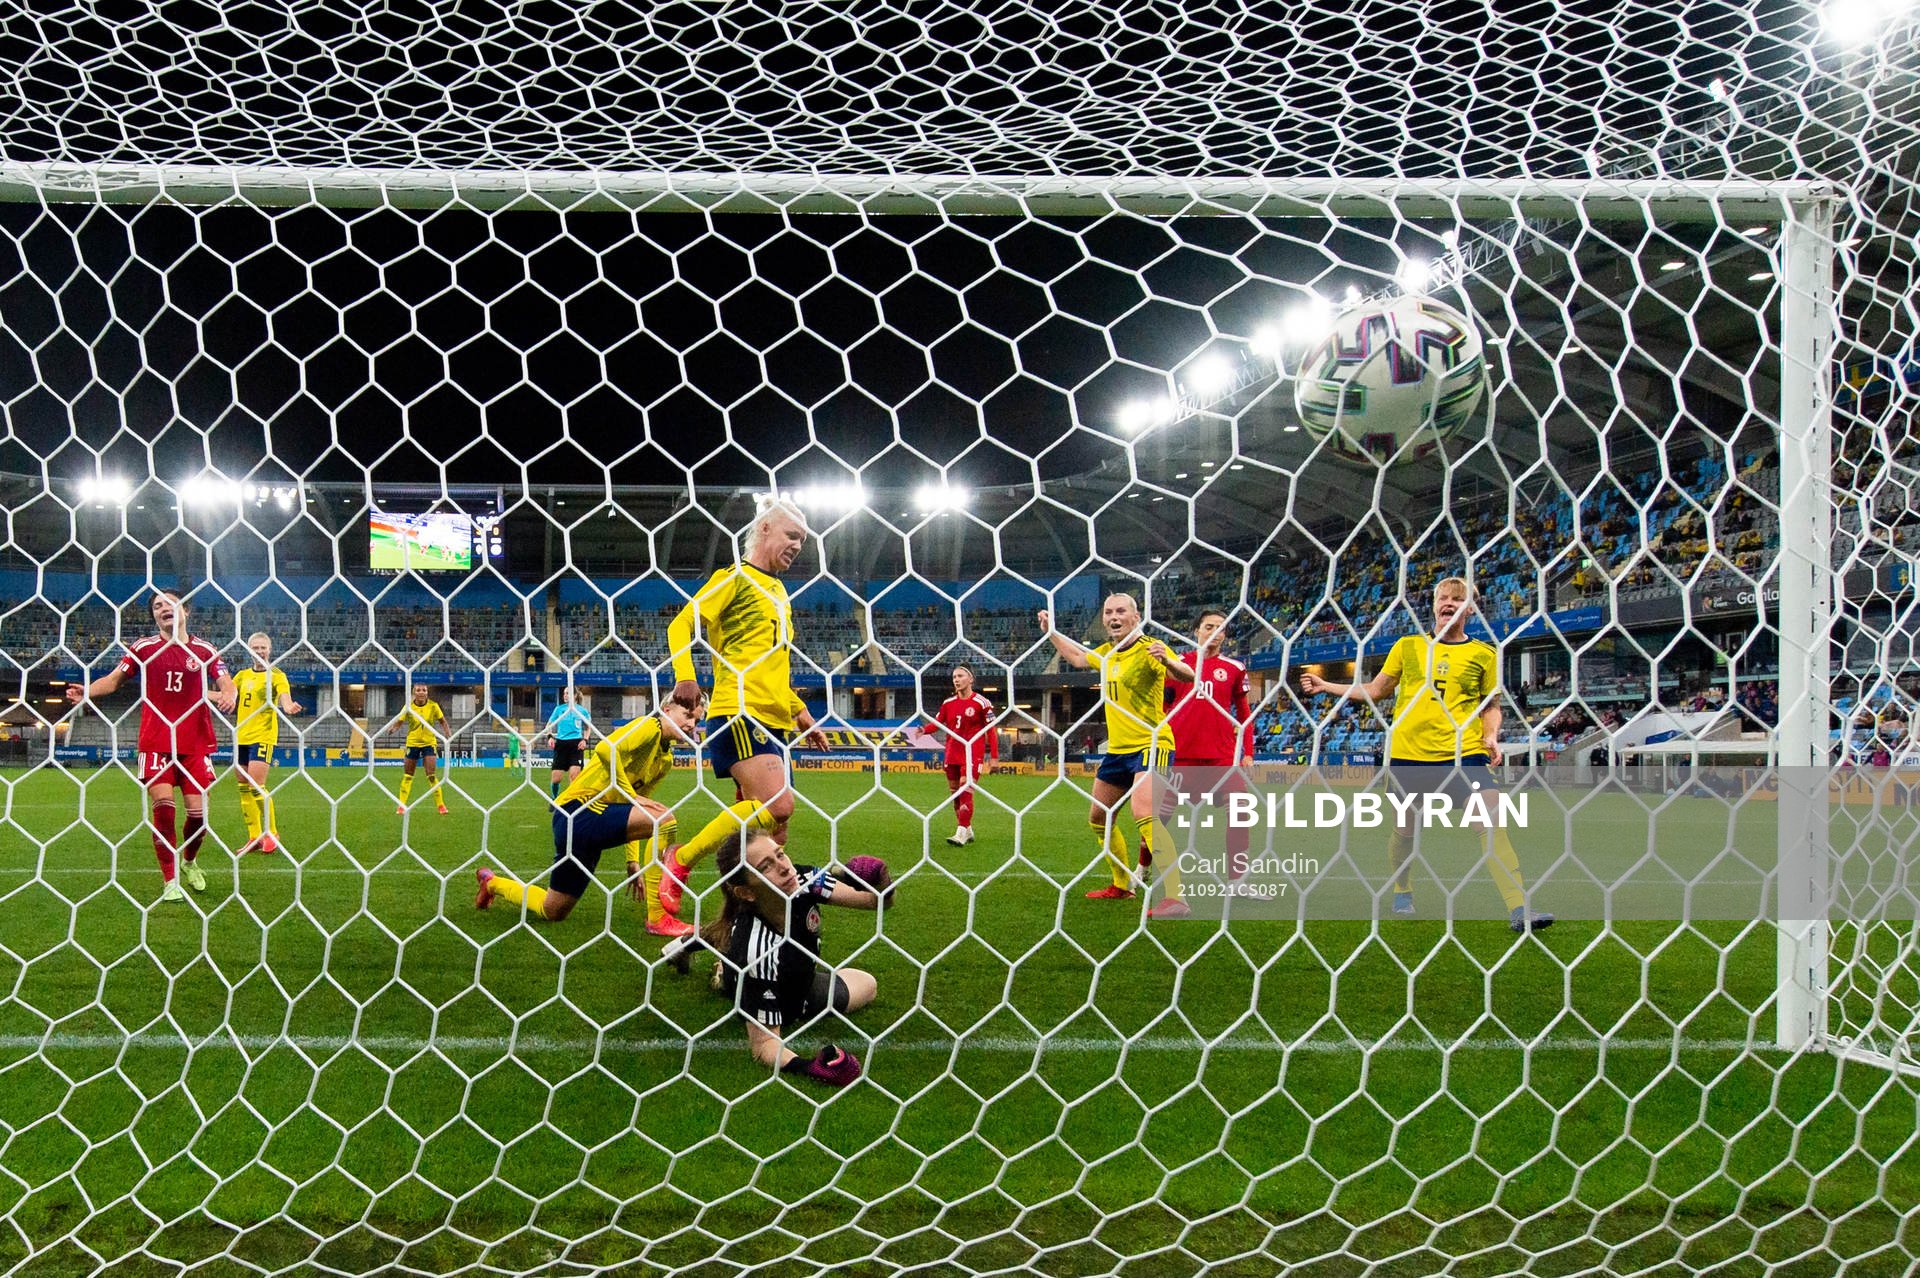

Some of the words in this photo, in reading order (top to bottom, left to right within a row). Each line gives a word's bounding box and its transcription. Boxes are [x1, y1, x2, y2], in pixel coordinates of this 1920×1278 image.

[164, 670, 184, 693] 13
[1107, 681, 1118, 701] 11
[1195, 680, 1213, 699] 20
[1430, 679, 1447, 700] 5
[243, 693, 252, 707] 2
[955, 715, 962, 729] 3
[257, 743, 267, 757] 2
[150, 751, 168, 770] 13
